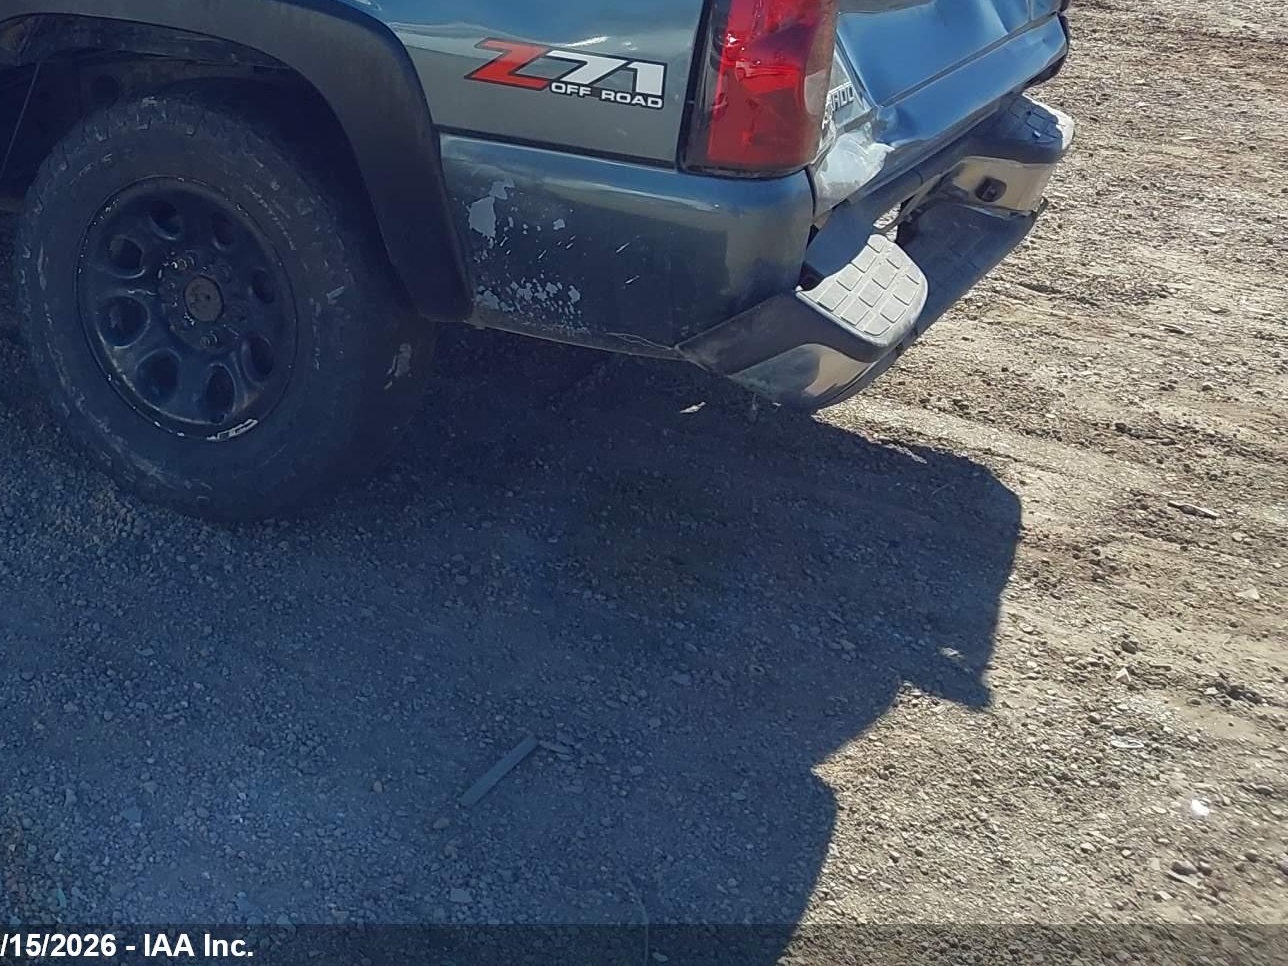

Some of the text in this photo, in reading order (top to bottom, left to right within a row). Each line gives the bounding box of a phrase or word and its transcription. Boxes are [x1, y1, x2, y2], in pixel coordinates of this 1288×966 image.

[465, 37, 667, 96] Z71
[550, 82, 664, 109] OFF ROAD
